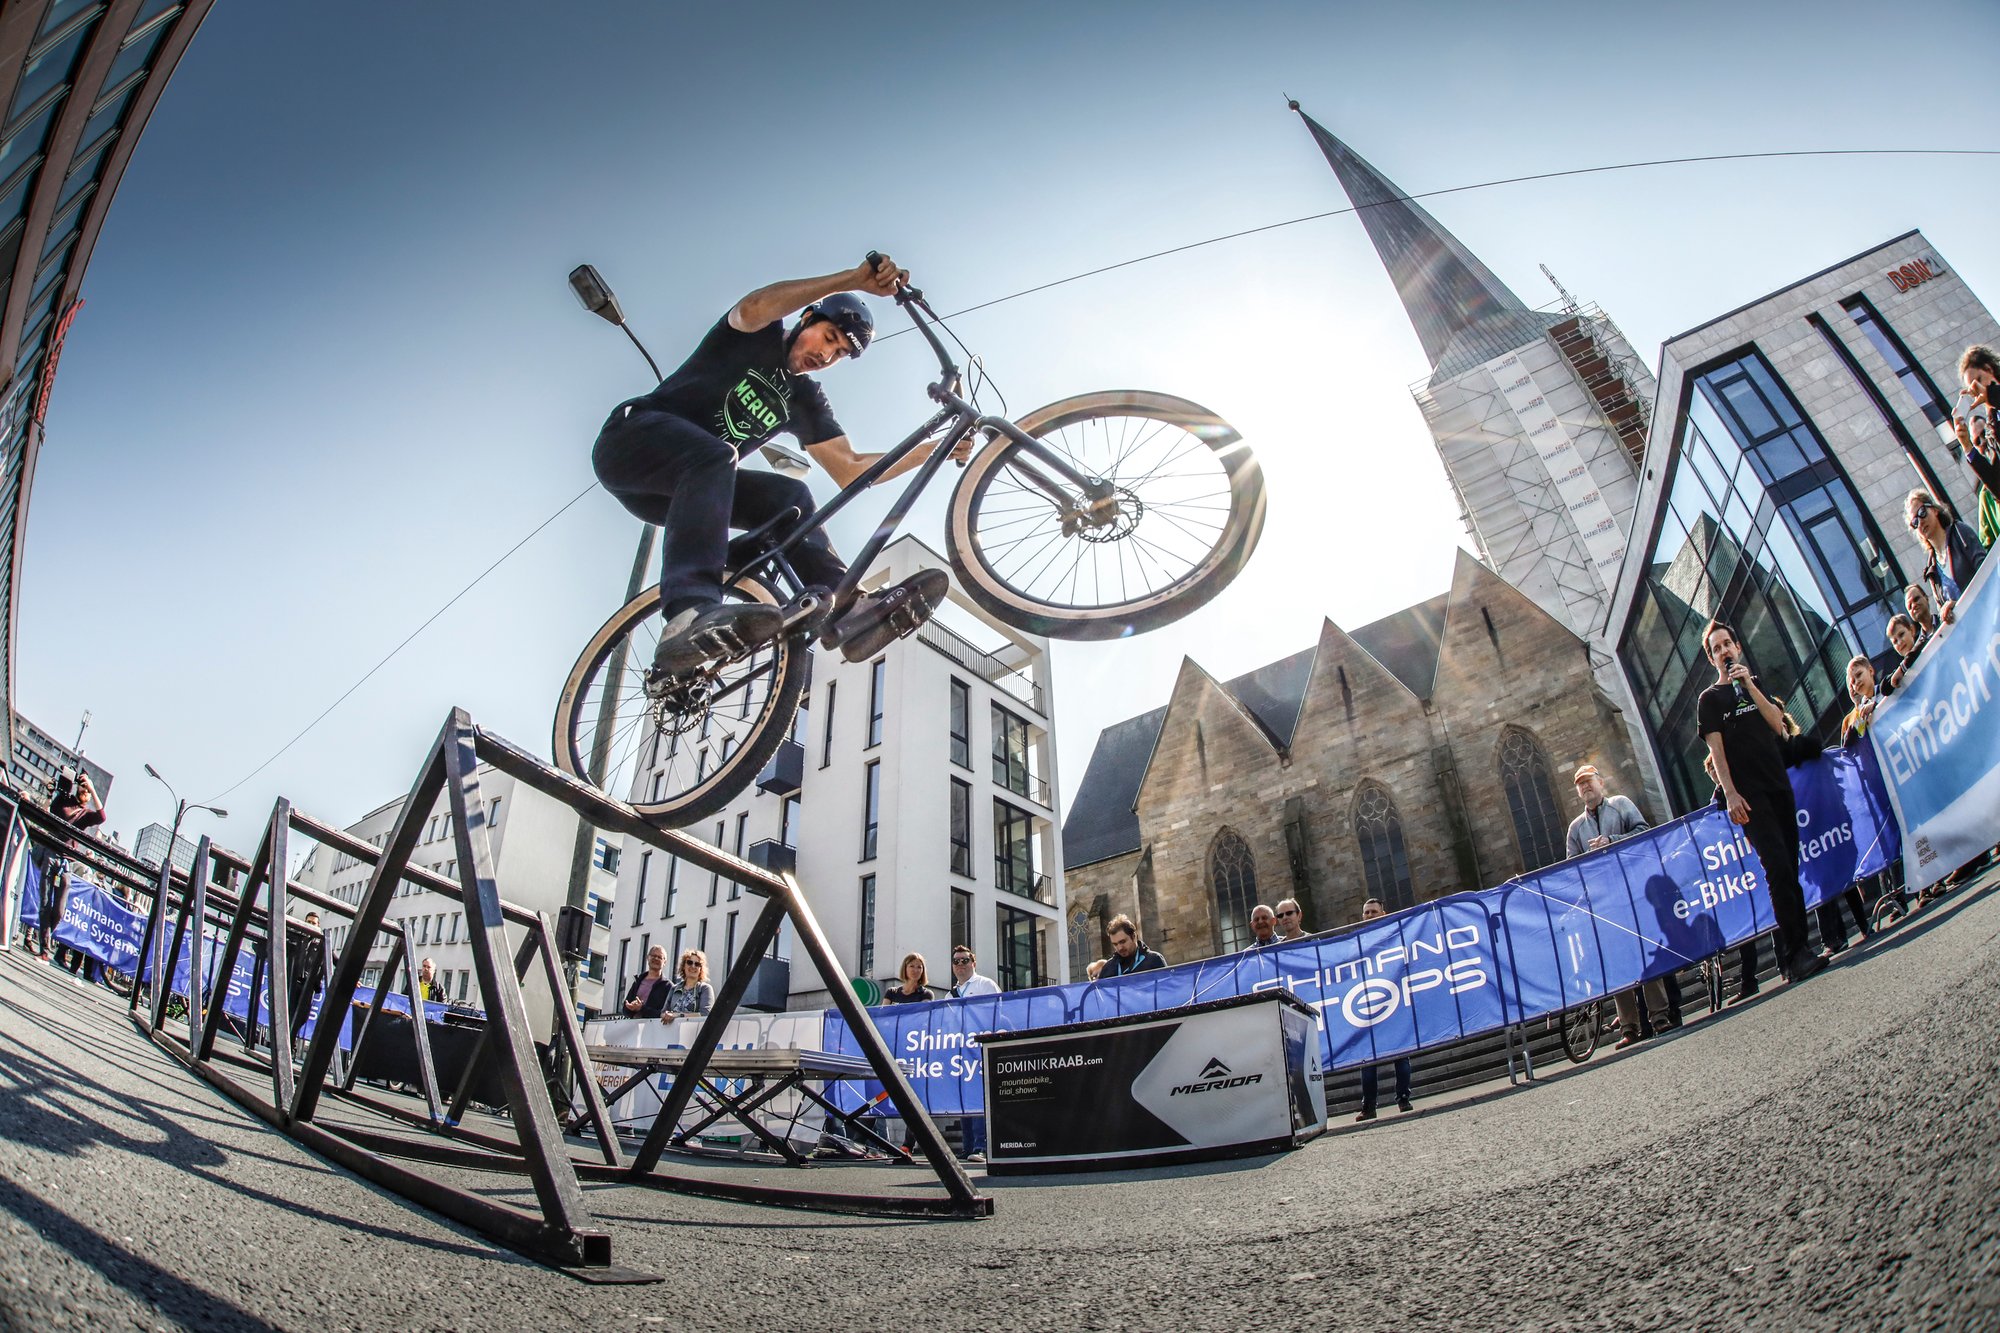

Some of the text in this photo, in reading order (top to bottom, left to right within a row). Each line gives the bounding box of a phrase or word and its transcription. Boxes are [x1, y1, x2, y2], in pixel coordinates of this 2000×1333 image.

[734, 378, 778, 428] MERID
[1883, 656, 1991, 785] Einfach
[72, 897, 123, 933] Shimano
[1673, 871, 1756, 919] e-Bike
[63, 908, 140, 957] Bike Systems
[997, 1054, 1103, 1074] DOMINIKRAAB.com
[1170, 1073, 1263, 1096] MERIDA
[1000, 1141, 1037, 1149] MERIDA.com
